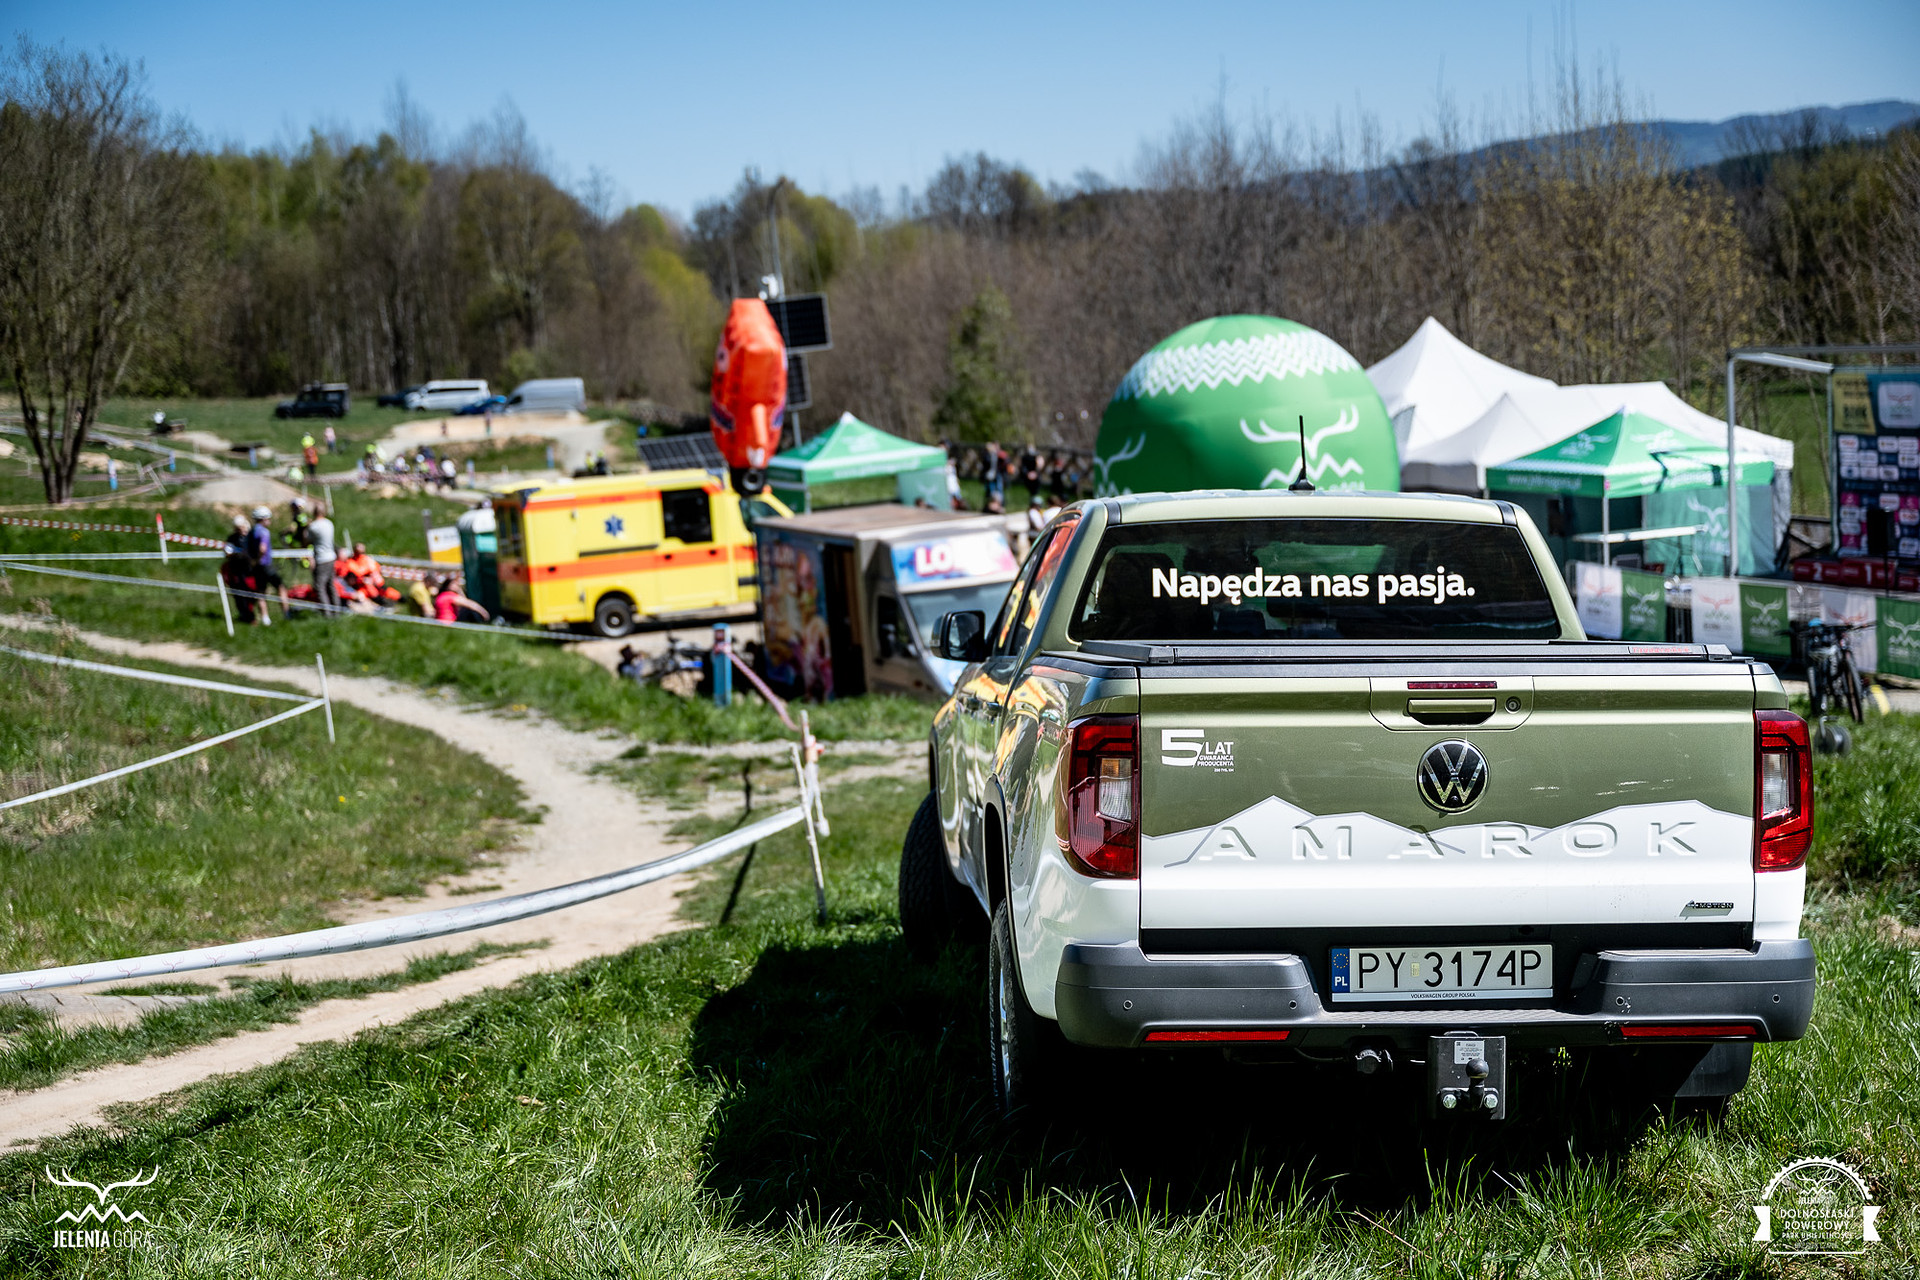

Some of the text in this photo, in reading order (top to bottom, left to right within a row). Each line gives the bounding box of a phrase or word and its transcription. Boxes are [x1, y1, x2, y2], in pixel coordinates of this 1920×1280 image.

[1152, 566, 1476, 605] Napędza nas pasja.
[1161, 729, 1234, 768] 5 LAT
[1199, 821, 1698, 861] AMAROK
[1334, 977, 1348, 987] PL
[1358, 950, 1542, 988] PY 3174P
